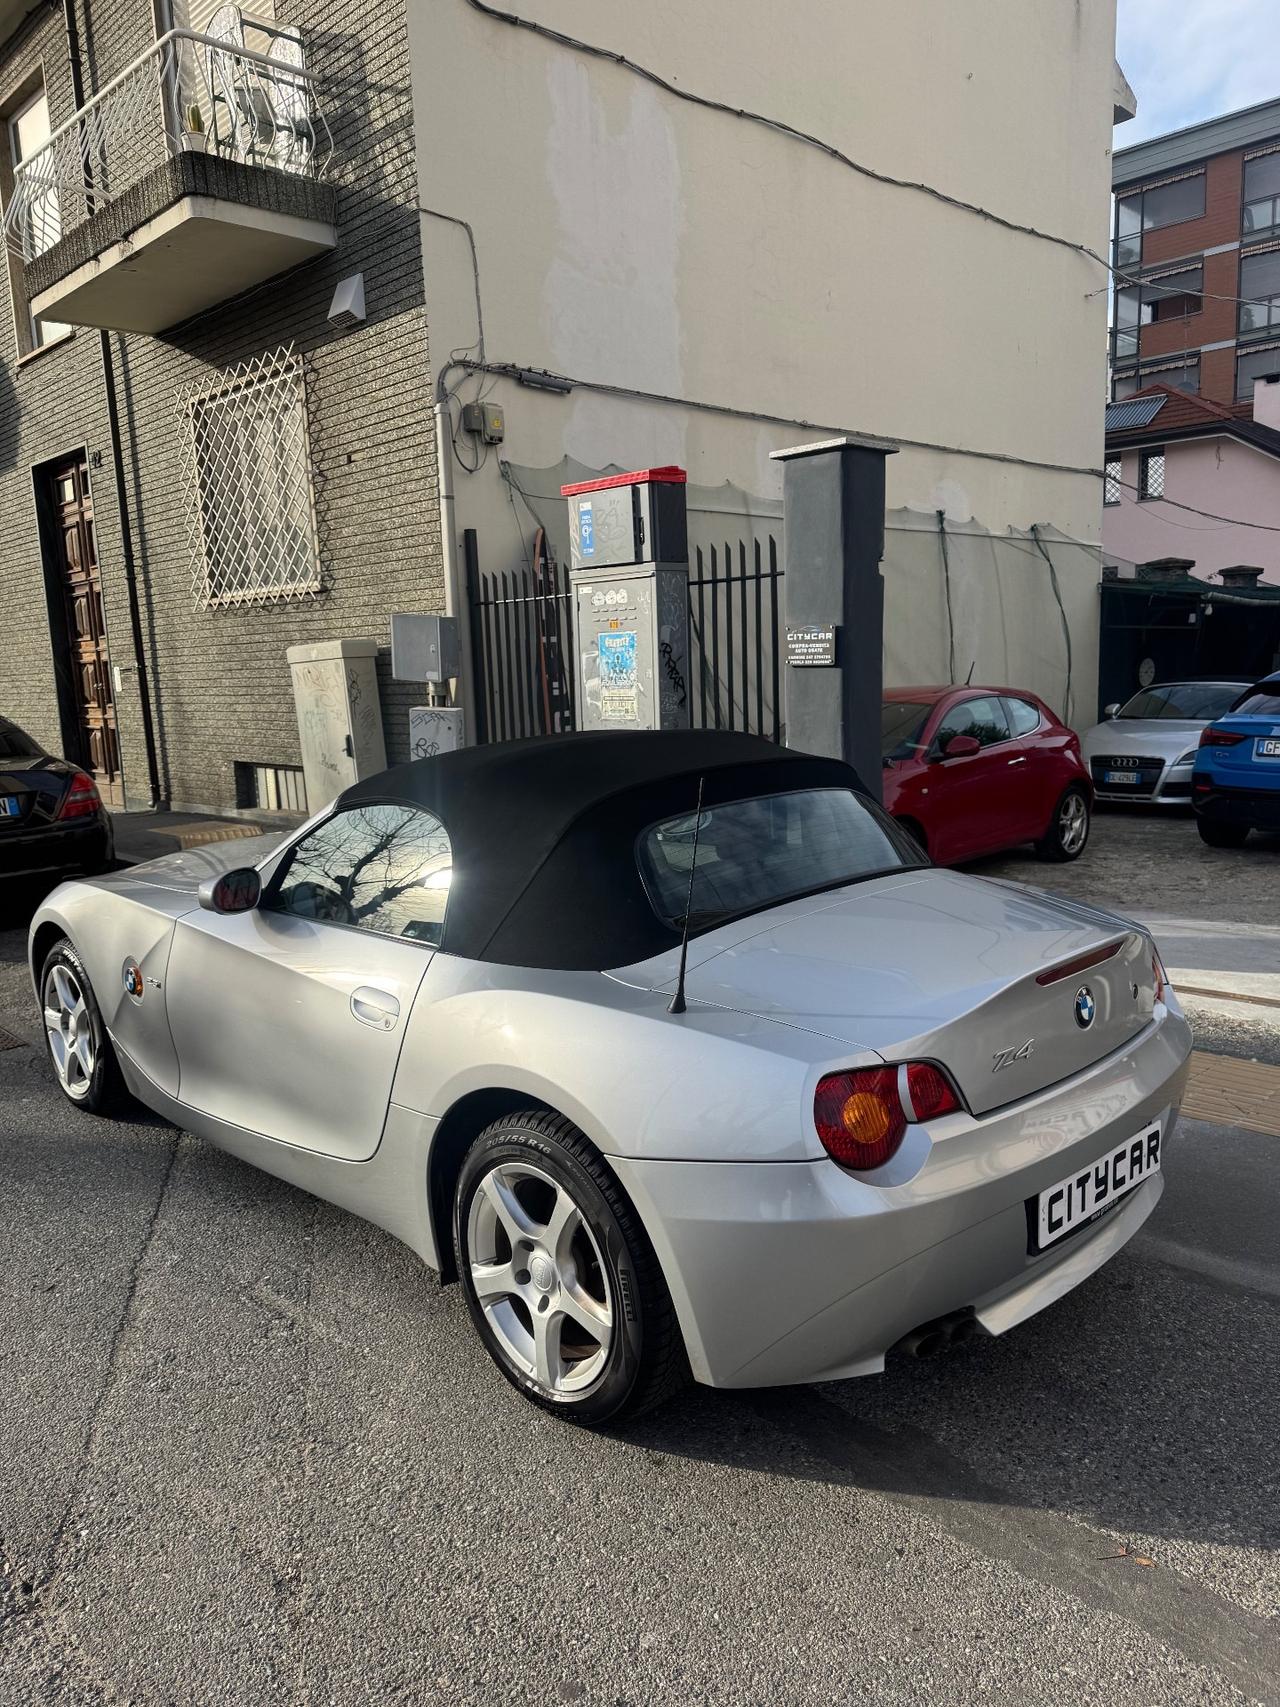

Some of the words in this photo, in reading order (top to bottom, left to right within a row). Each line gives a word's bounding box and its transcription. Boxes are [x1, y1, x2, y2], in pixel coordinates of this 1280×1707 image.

[787, 632, 833, 641] CITYCAR
[992, 1037, 1035, 1073] Z4
[486, 1134, 527, 1149] 205/55
[527, 1138, 552, 1154] R16
[1047, 1129, 1160, 1235] CITYCAR
